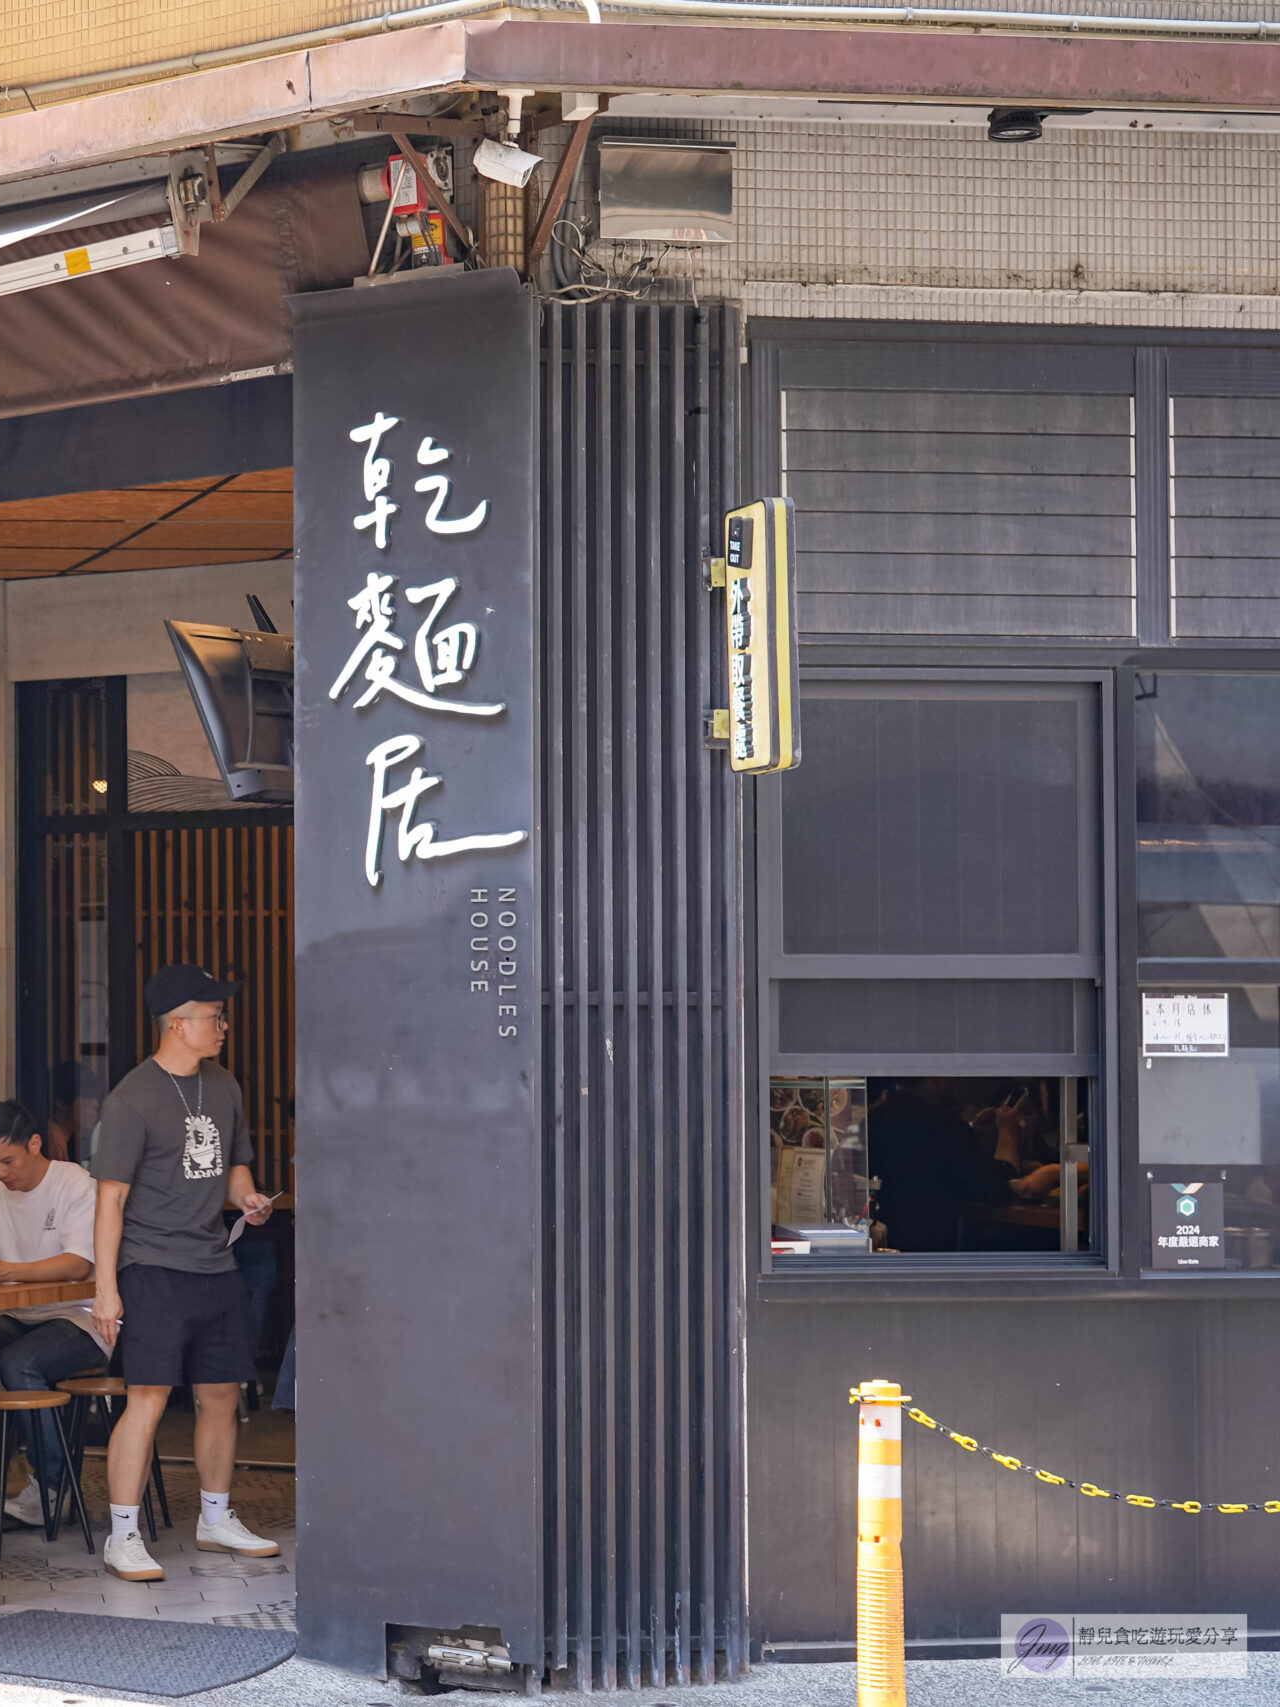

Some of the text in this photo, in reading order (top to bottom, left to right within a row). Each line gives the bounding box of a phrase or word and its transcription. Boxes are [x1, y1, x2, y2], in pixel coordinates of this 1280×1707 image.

[329, 411, 529, 888] 乾麵居
[470, 888, 489, 993] HOUSE
[498, 888, 517, 1038] NOODLES
[1176, 1225, 1200, 1235] 2024
